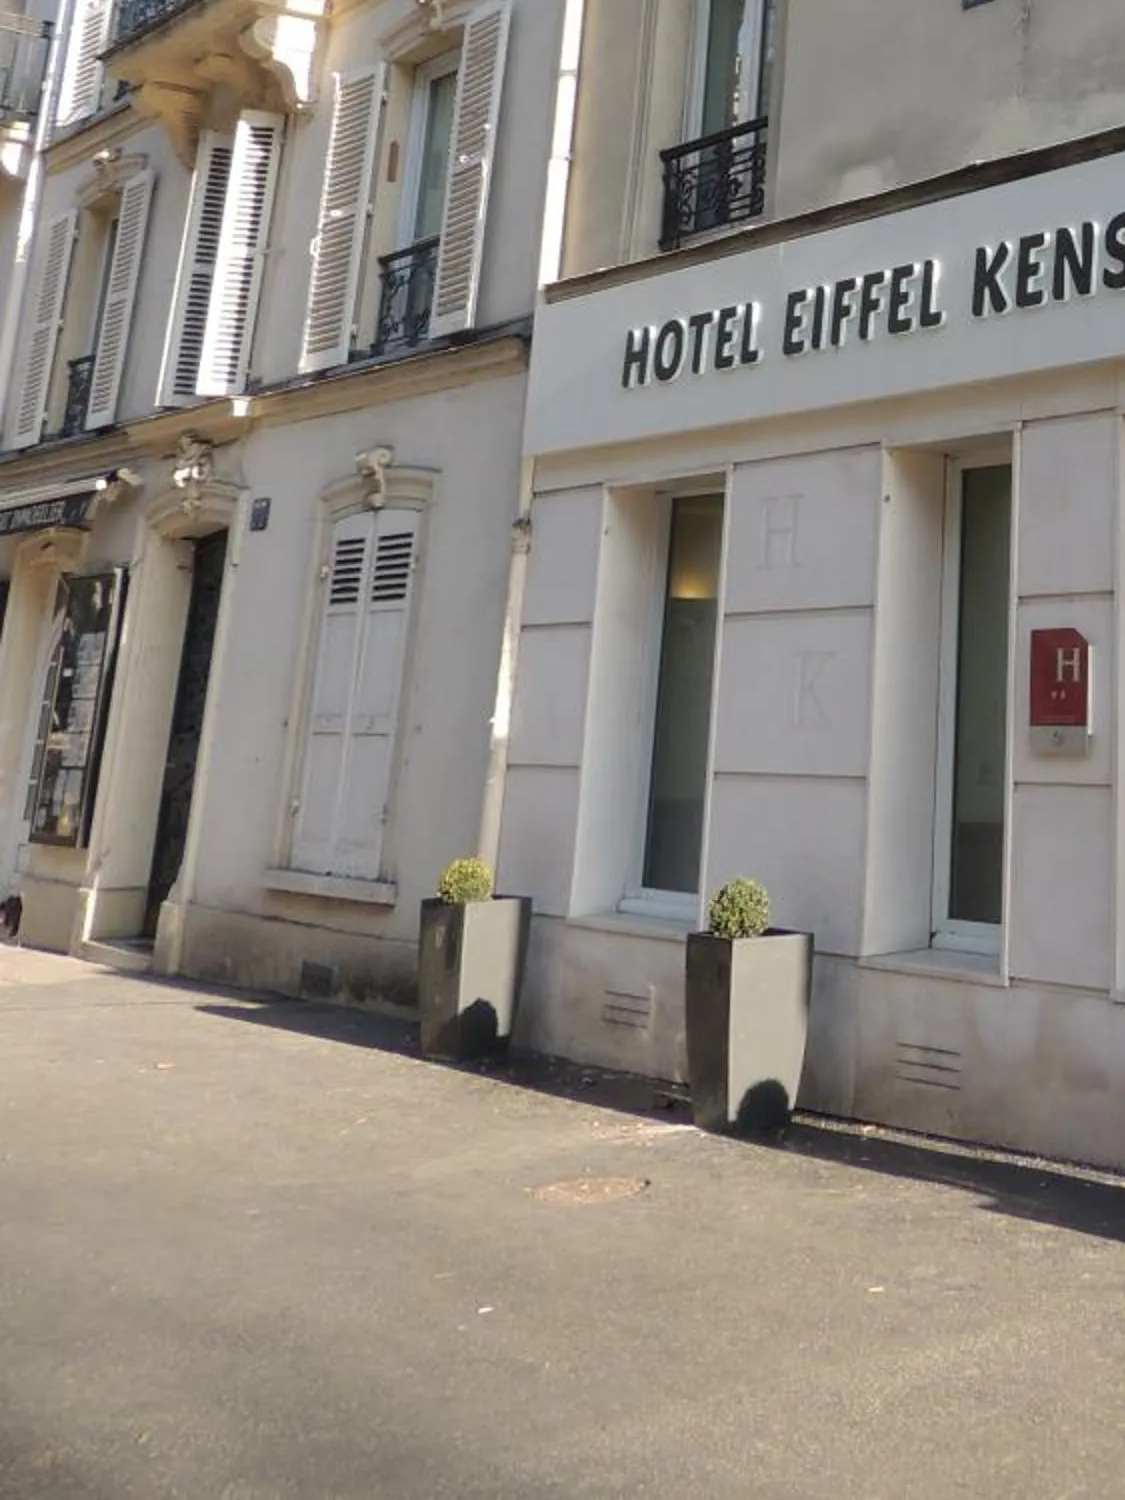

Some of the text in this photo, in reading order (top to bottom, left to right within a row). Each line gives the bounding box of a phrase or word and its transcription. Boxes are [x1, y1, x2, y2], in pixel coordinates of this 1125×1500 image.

[621, 303, 760, 389] HOTEL
[782, 259, 943, 357] EIFFEL
[1056, 647, 1080, 683] H
